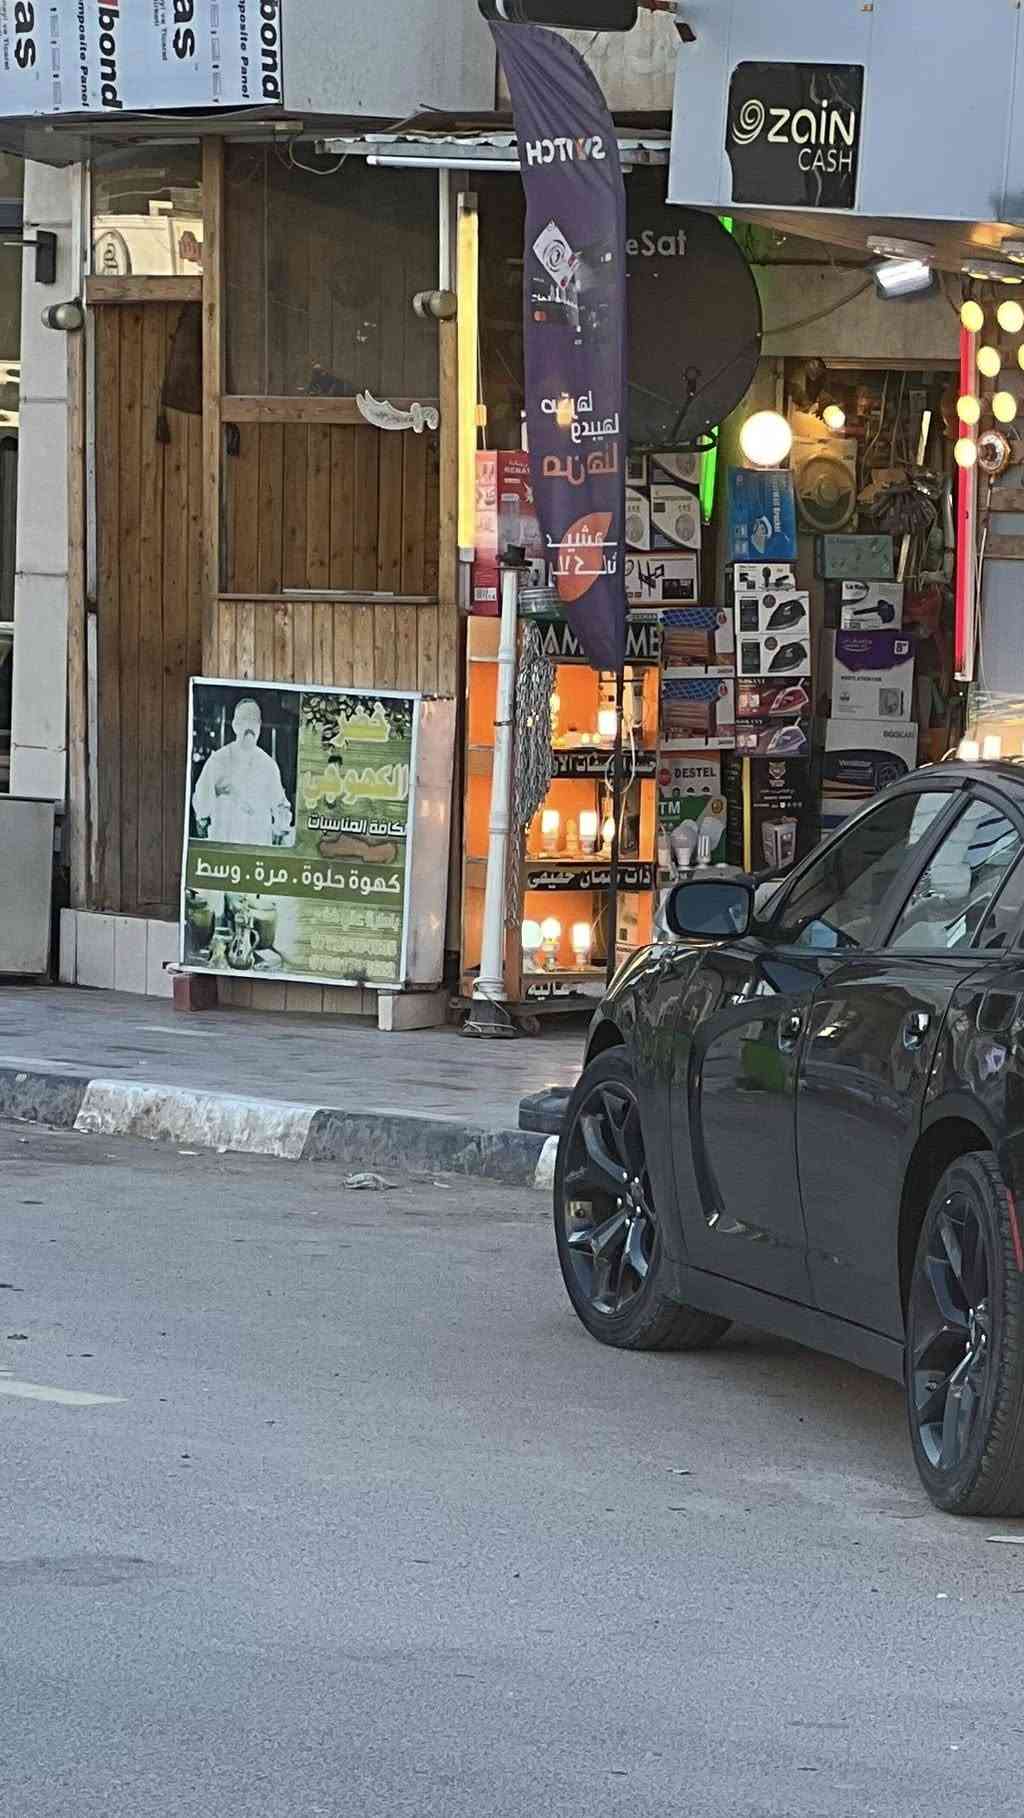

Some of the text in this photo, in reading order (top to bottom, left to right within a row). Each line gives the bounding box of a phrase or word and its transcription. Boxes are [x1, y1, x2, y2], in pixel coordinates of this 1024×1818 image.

[80, 65, 90, 107] Panel
[767, 98, 856, 146] zain
[798, 147, 853, 173] CASH
[307, 815, 367, 836] المناسبات
[195, 857, 401, 895] كهوة حلوة مرة وسط
